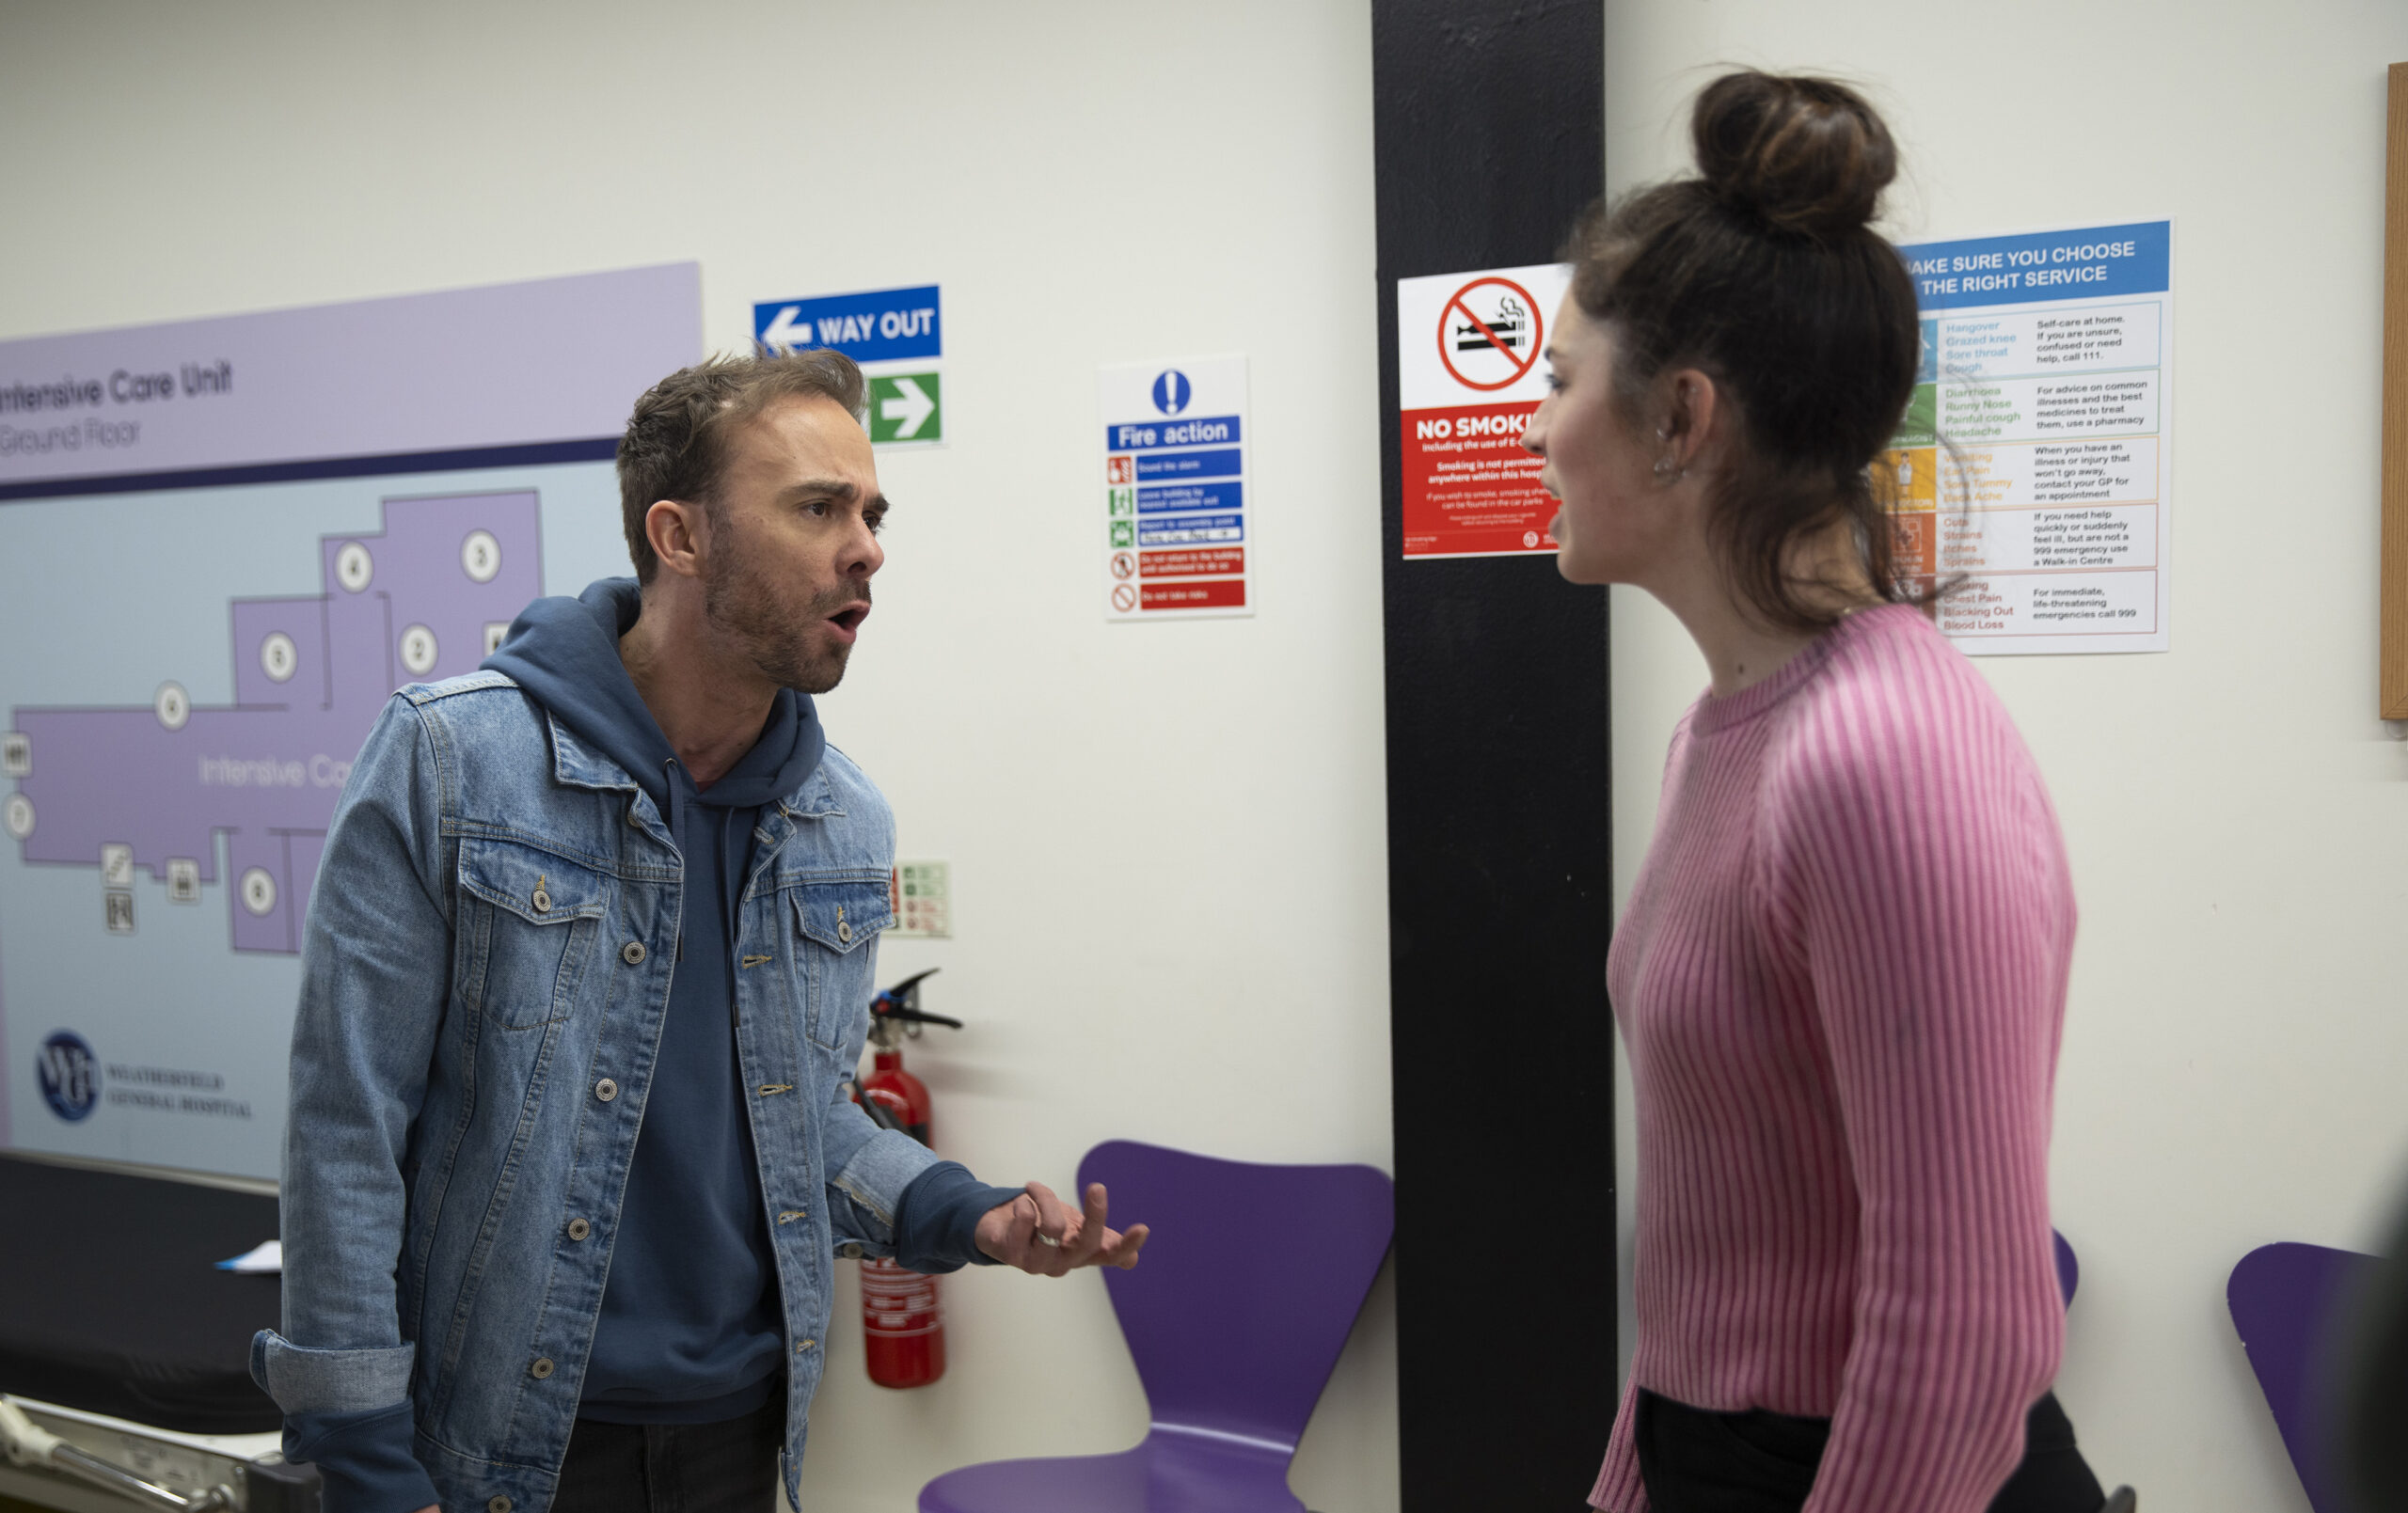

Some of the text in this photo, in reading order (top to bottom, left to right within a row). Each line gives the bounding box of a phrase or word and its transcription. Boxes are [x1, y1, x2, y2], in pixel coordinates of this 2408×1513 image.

[1907, 241, 2135, 276] AKE SURE YOU CHOOSE
[1922, 265, 2107, 296] THE RIGHT SERVICE
[817, 307, 935, 345] WAY OUT
[2037, 315, 2125, 329] Self-care at home.
[2037, 331, 2043, 339] If
[2047, 332, 2065, 341] you
[2085, 328, 2122, 339] unsure,
[2036, 340, 2082, 352] confused
[2098, 338, 2122, 348] need
[2036, 351, 2103, 366] help, call 111.
[0, 357, 232, 415] ntensive Care Unit
[2037, 386, 2052, 394] For
[2055, 383, 2087, 393] advice
[2105, 382, 2147, 390] common
[2037, 392, 2142, 406] illnesses and the best
[2036, 404, 2124, 417] medicines to treat
[1946, 412, 2021, 424] Painful cough
[2037, 419, 2065, 430] them,
[2096, 416, 2145, 428] pharmacy
[1417, 414, 1534, 440] NO SMOKI
[1118, 420, 1228, 448] Fire action
[1465, 439, 1479, 449] the
[1481, 439, 1497, 449] use
[1497, 437, 1508, 448] of
[2036, 446, 2062, 455] When
[2065, 446, 2082, 455] you
[2084, 443, 2107, 452] have
[1437, 457, 1545, 471] Smoking is not permitted
[2036, 456, 2066, 465] illness
[2082, 454, 2108, 466] injury
[2111, 453, 2130, 463] that
[1429, 469, 1542, 485] anywhere within this hosp
[2035, 467, 2106, 478] won't go away,
[2035, 476, 2129, 489] contact your GP for
[2049, 489, 2110, 502] appointment
[2035, 510, 2112, 522] If you need help
[2034, 523, 2067, 534] quickly
[2083, 521, 2128, 533] suddenly
[2034, 534, 2052, 544] feel
[2054, 534, 2065, 544] ill,
[2068, 533, 2083, 543] but
[2104, 532, 2120, 541] not
[2034, 545, 2051, 555] 999
[2053, 546, 2107, 557] emergency
[2042, 557, 2077, 566] Walk-in
[2080, 556, 2113, 564] Centre
[1978, 593, 2002, 602] Pain
[2034, 587, 2104, 597] For immediate,
[2034, 598, 2107, 610] life-threatening
[1994, 607, 2014, 615] Out
[2034, 608, 2136, 622] emergencies call 999
[1944, 621, 2004, 630] Blood Loss
[198, 754, 354, 788] Intensive Ca
